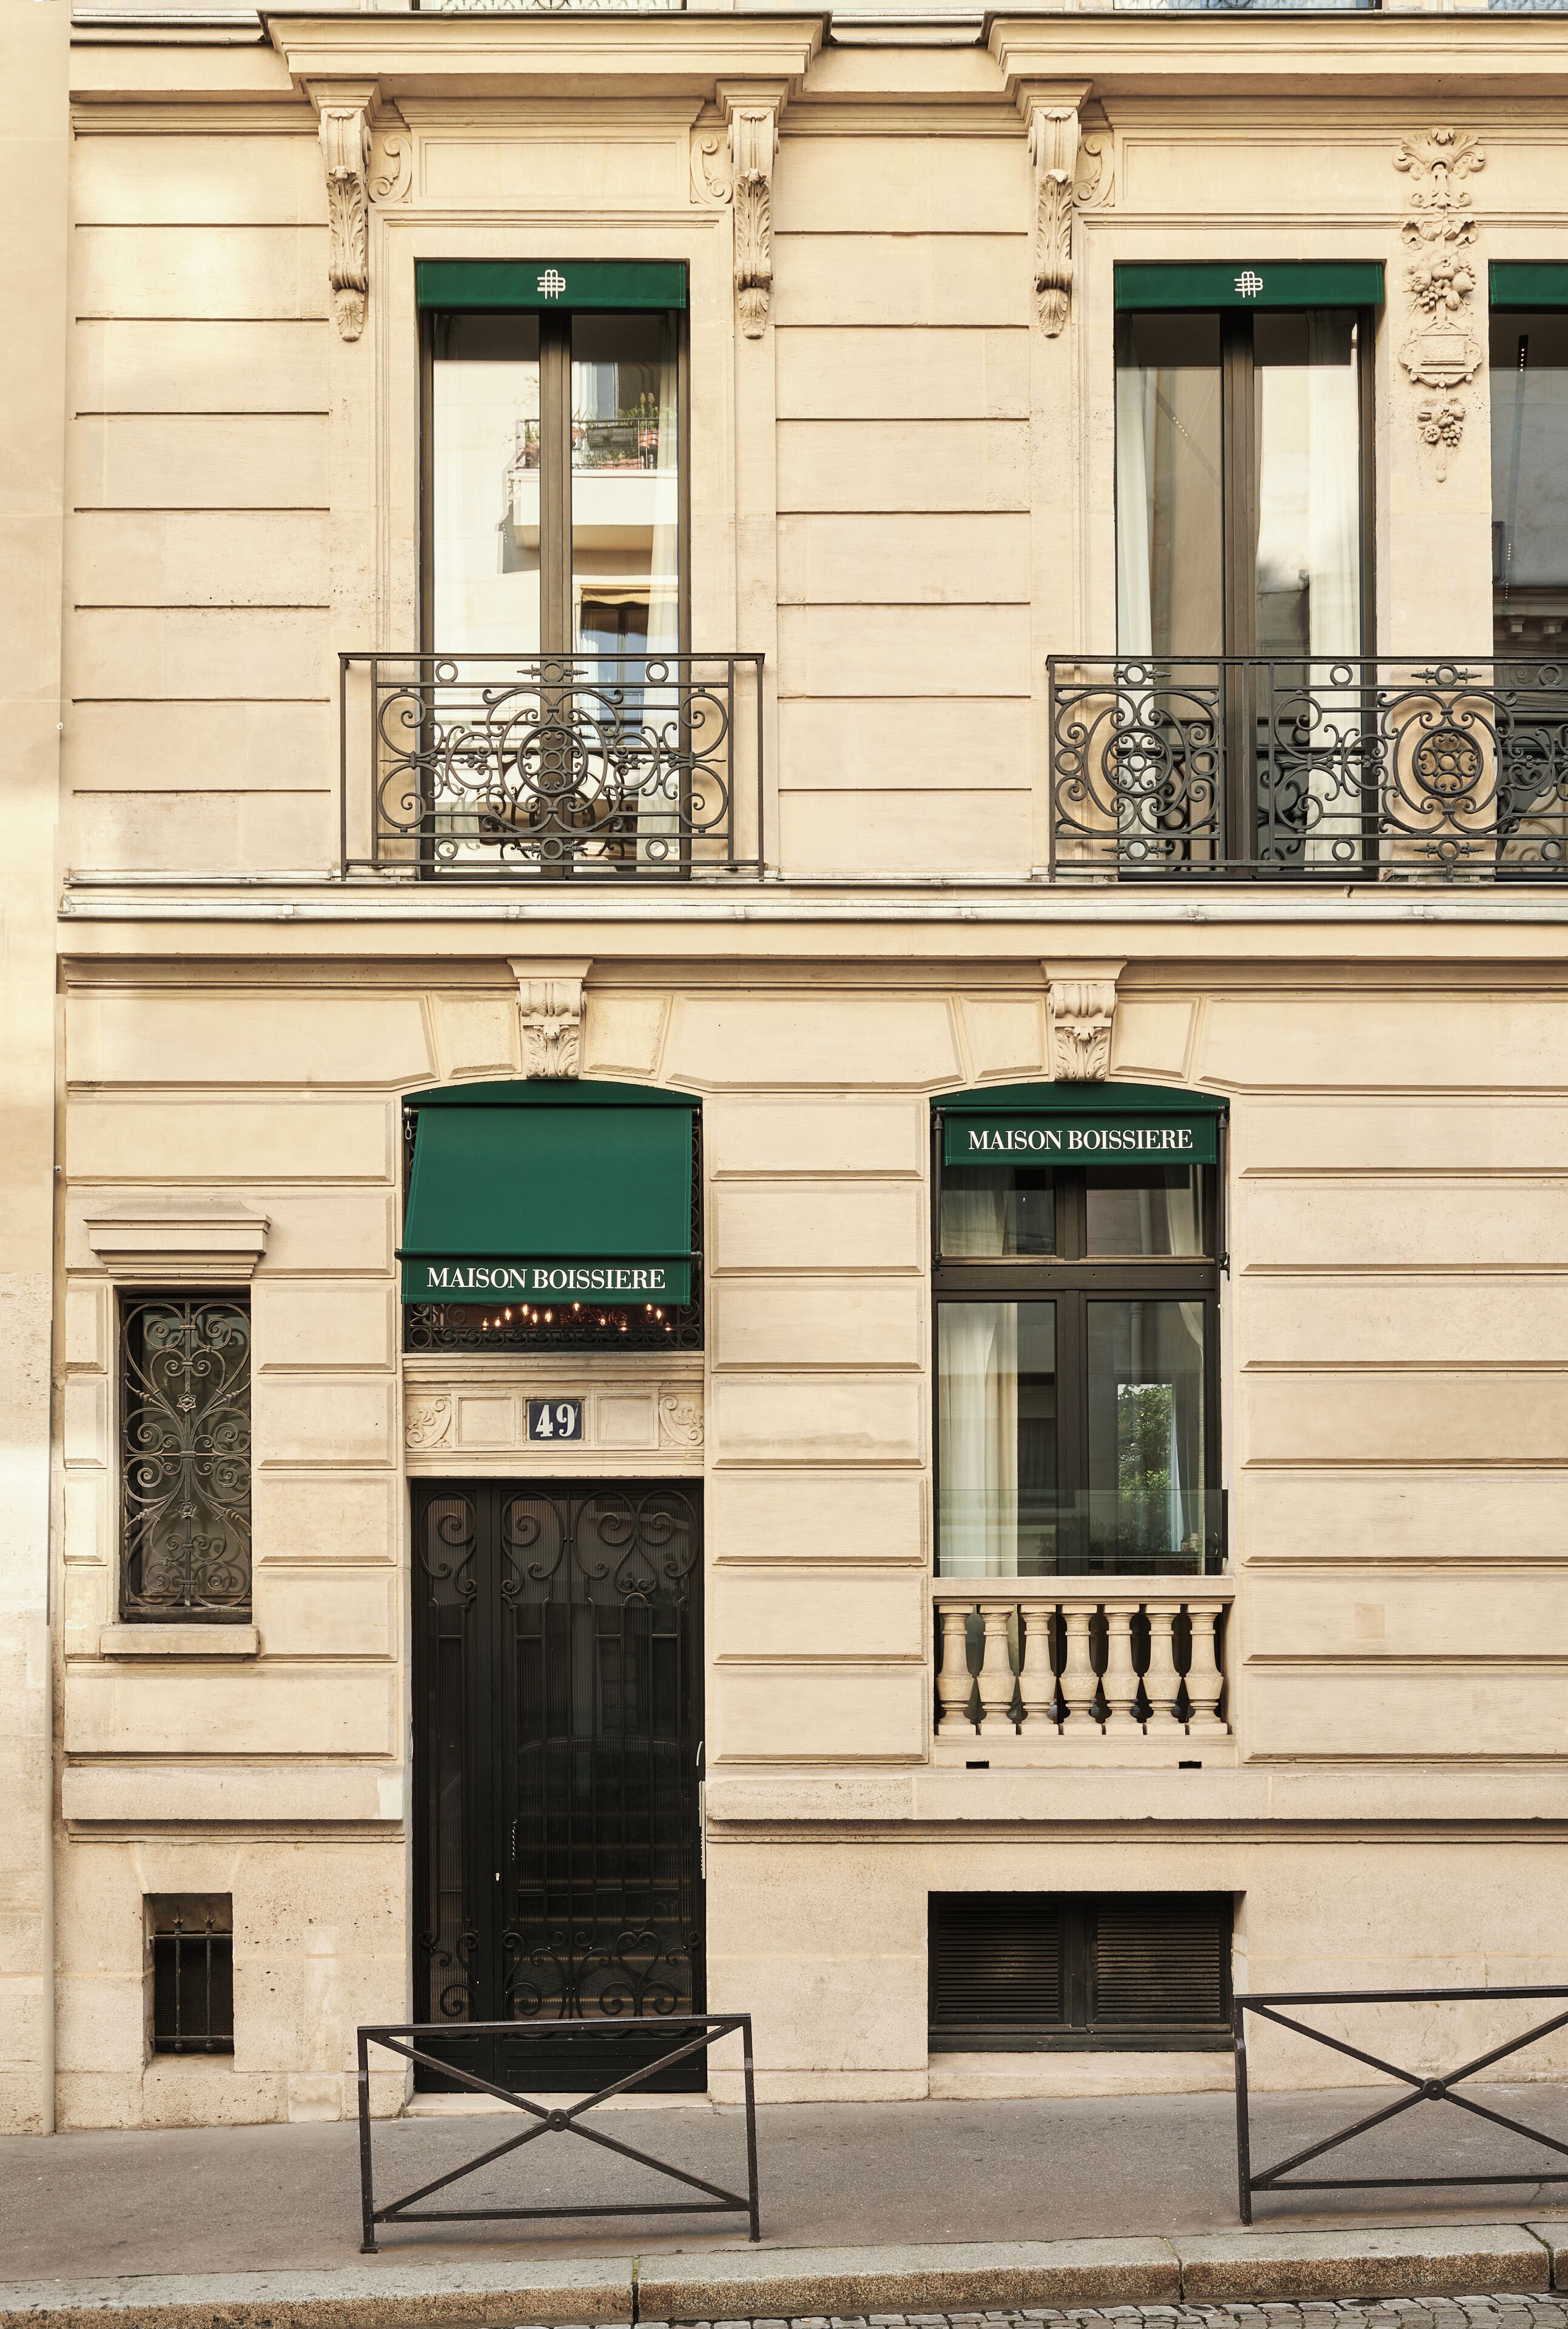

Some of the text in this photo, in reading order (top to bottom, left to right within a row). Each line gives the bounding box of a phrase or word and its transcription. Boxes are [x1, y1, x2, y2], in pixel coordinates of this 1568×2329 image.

[967, 1129, 1193, 1149] MAISON BOISSIERE
[427, 1268, 665, 1289] MAISON BOISSIERE
[535, 1403, 576, 1437] 49
